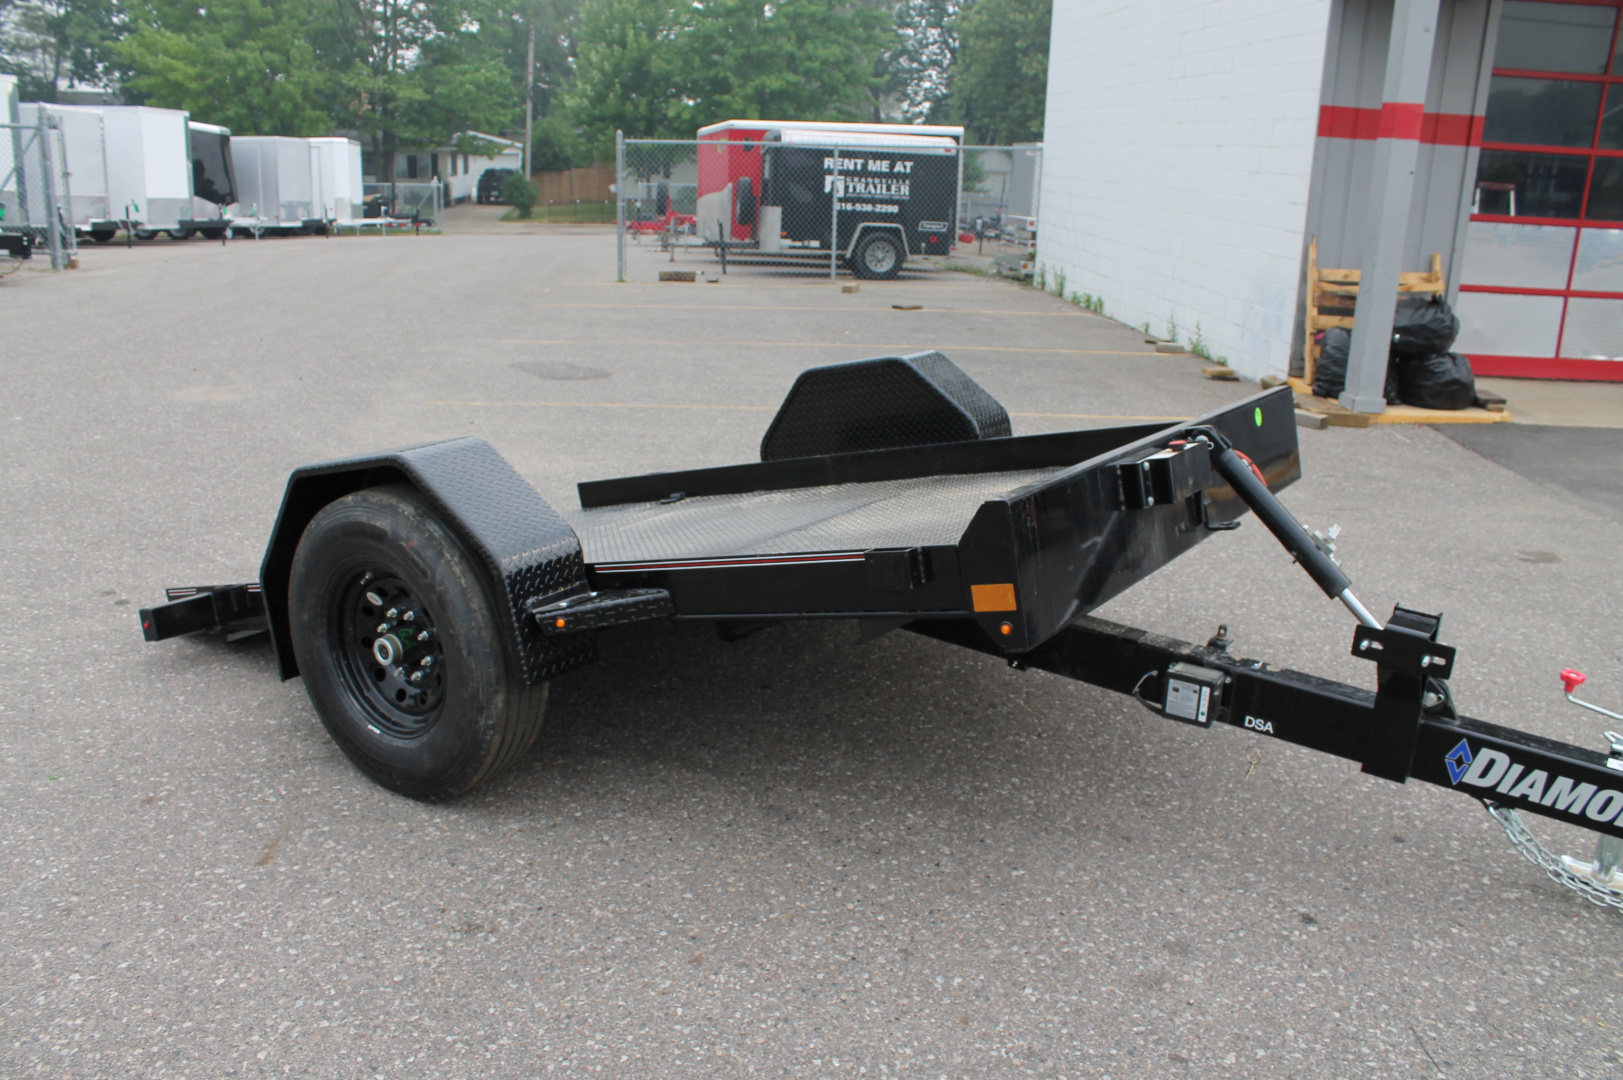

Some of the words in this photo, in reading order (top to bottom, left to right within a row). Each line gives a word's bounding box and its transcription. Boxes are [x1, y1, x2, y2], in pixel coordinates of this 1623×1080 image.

[824, 157, 864, 171] RENT
[868, 159, 890, 172] ME
[893, 161, 913, 173] AT
[846, 182, 910, 196] TRAILER
[1244, 715, 1274, 734] DSA
[1461, 747, 1623, 828] DIAMO
